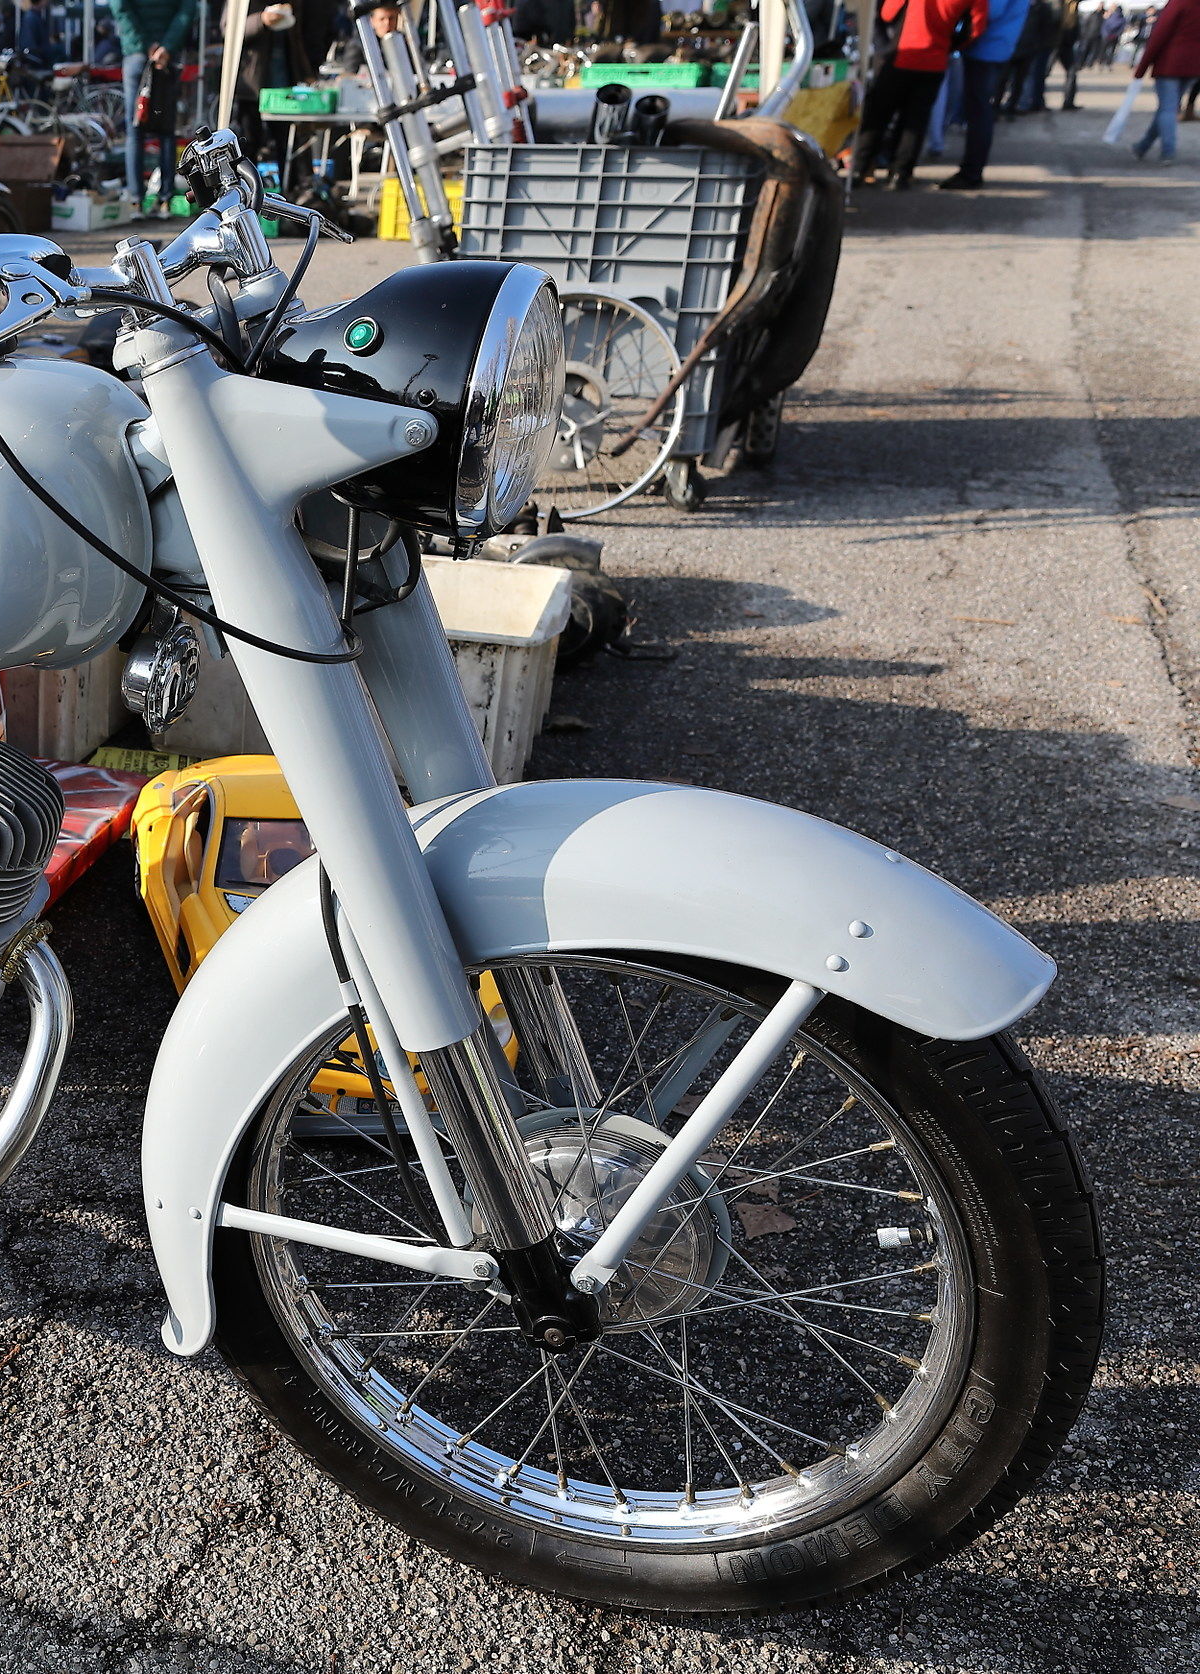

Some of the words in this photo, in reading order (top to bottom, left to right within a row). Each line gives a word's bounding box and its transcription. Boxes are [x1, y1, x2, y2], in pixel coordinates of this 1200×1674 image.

[916, 1386, 997, 1500] CITY
[421, 1496, 514, 1550] 2.75-17
[728, 1491, 914, 1585] DEMON
